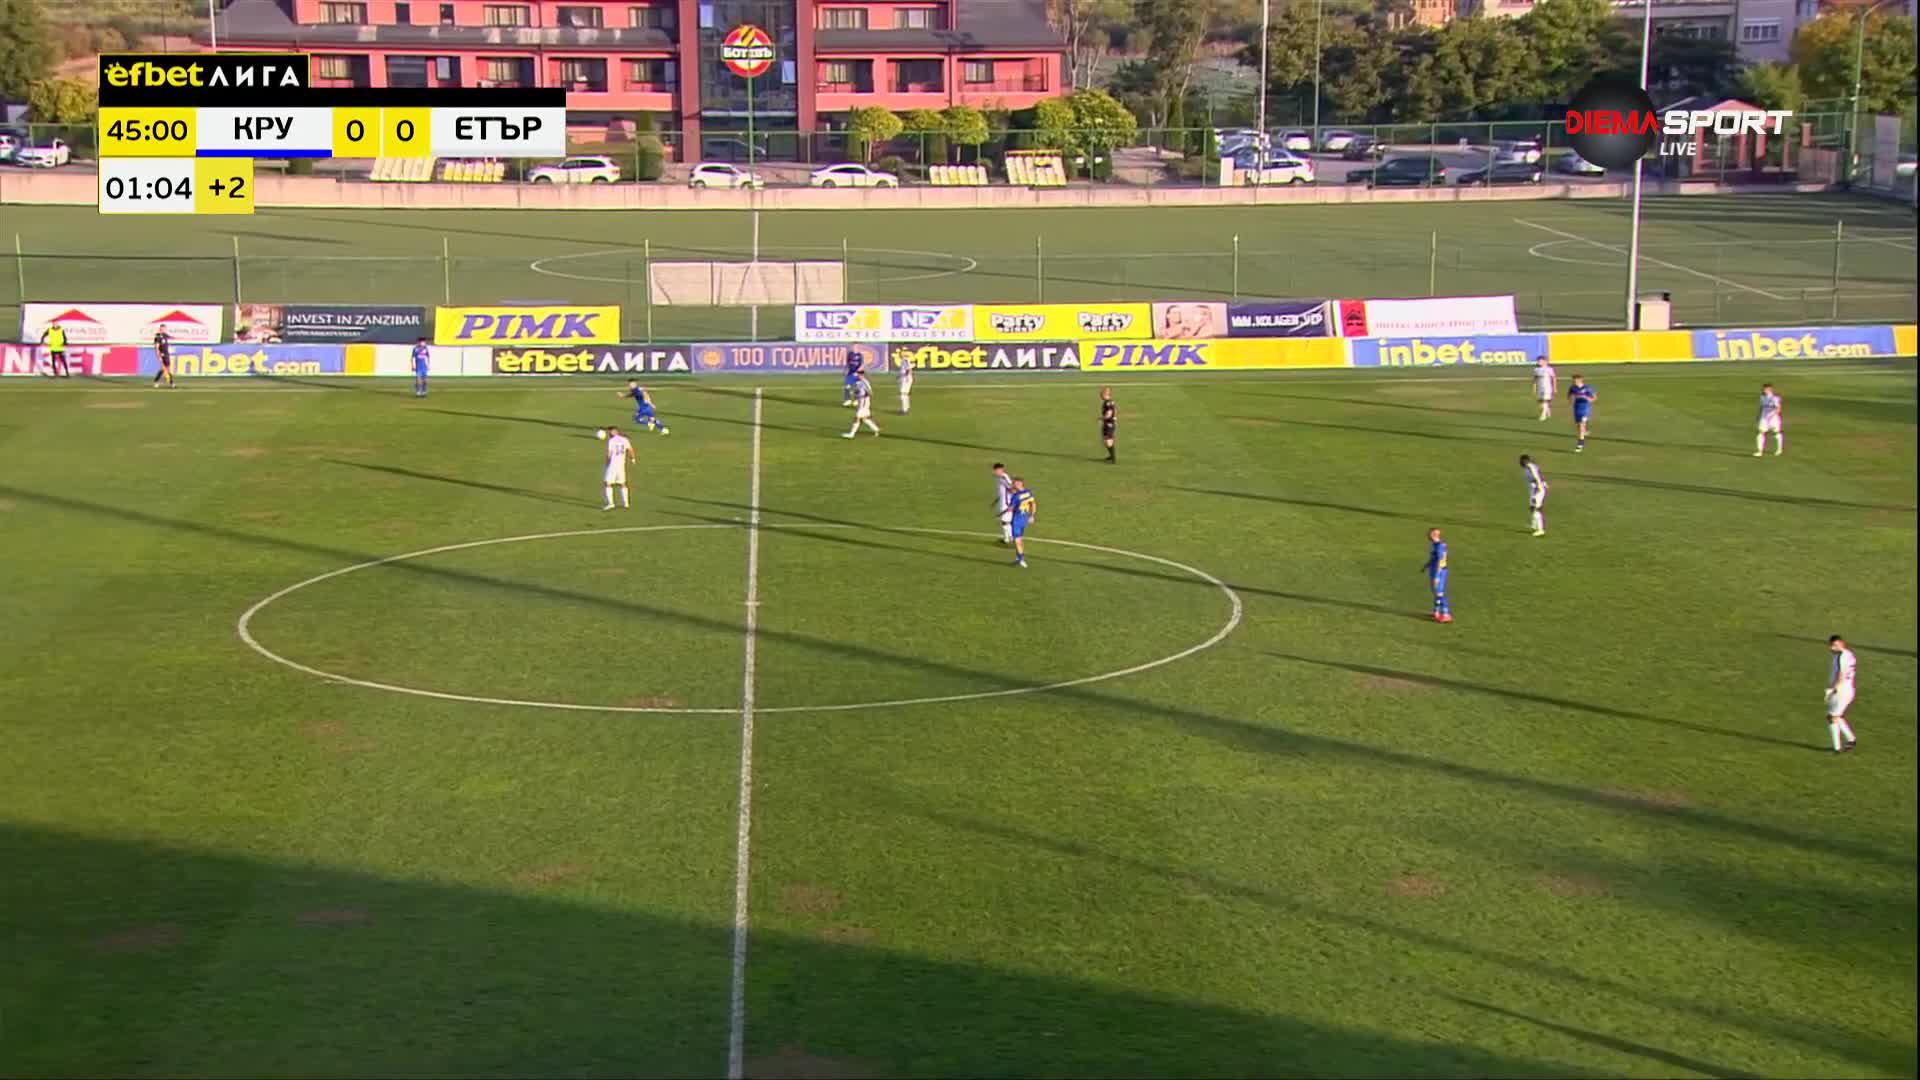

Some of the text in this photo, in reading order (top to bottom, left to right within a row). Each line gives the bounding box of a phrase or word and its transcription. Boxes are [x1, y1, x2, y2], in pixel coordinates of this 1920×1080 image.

[287, 314, 420, 326] INVEST IN ZANZIBAR
[455, 313, 601, 340] PIMK
[990, 312, 1045, 328] Party
[1077, 311, 1133, 327] Party
[1089, 343, 1209, 366] PIMK
[1378, 337, 1527, 367] inbet.com
[1715, 331, 1872, 360] inbet.com
[598, 352, 689, 372] ЛИГА
[731, 348, 848, 369] 100 ГОДИНИ
[991, 347, 1080, 369] ЛИГА
